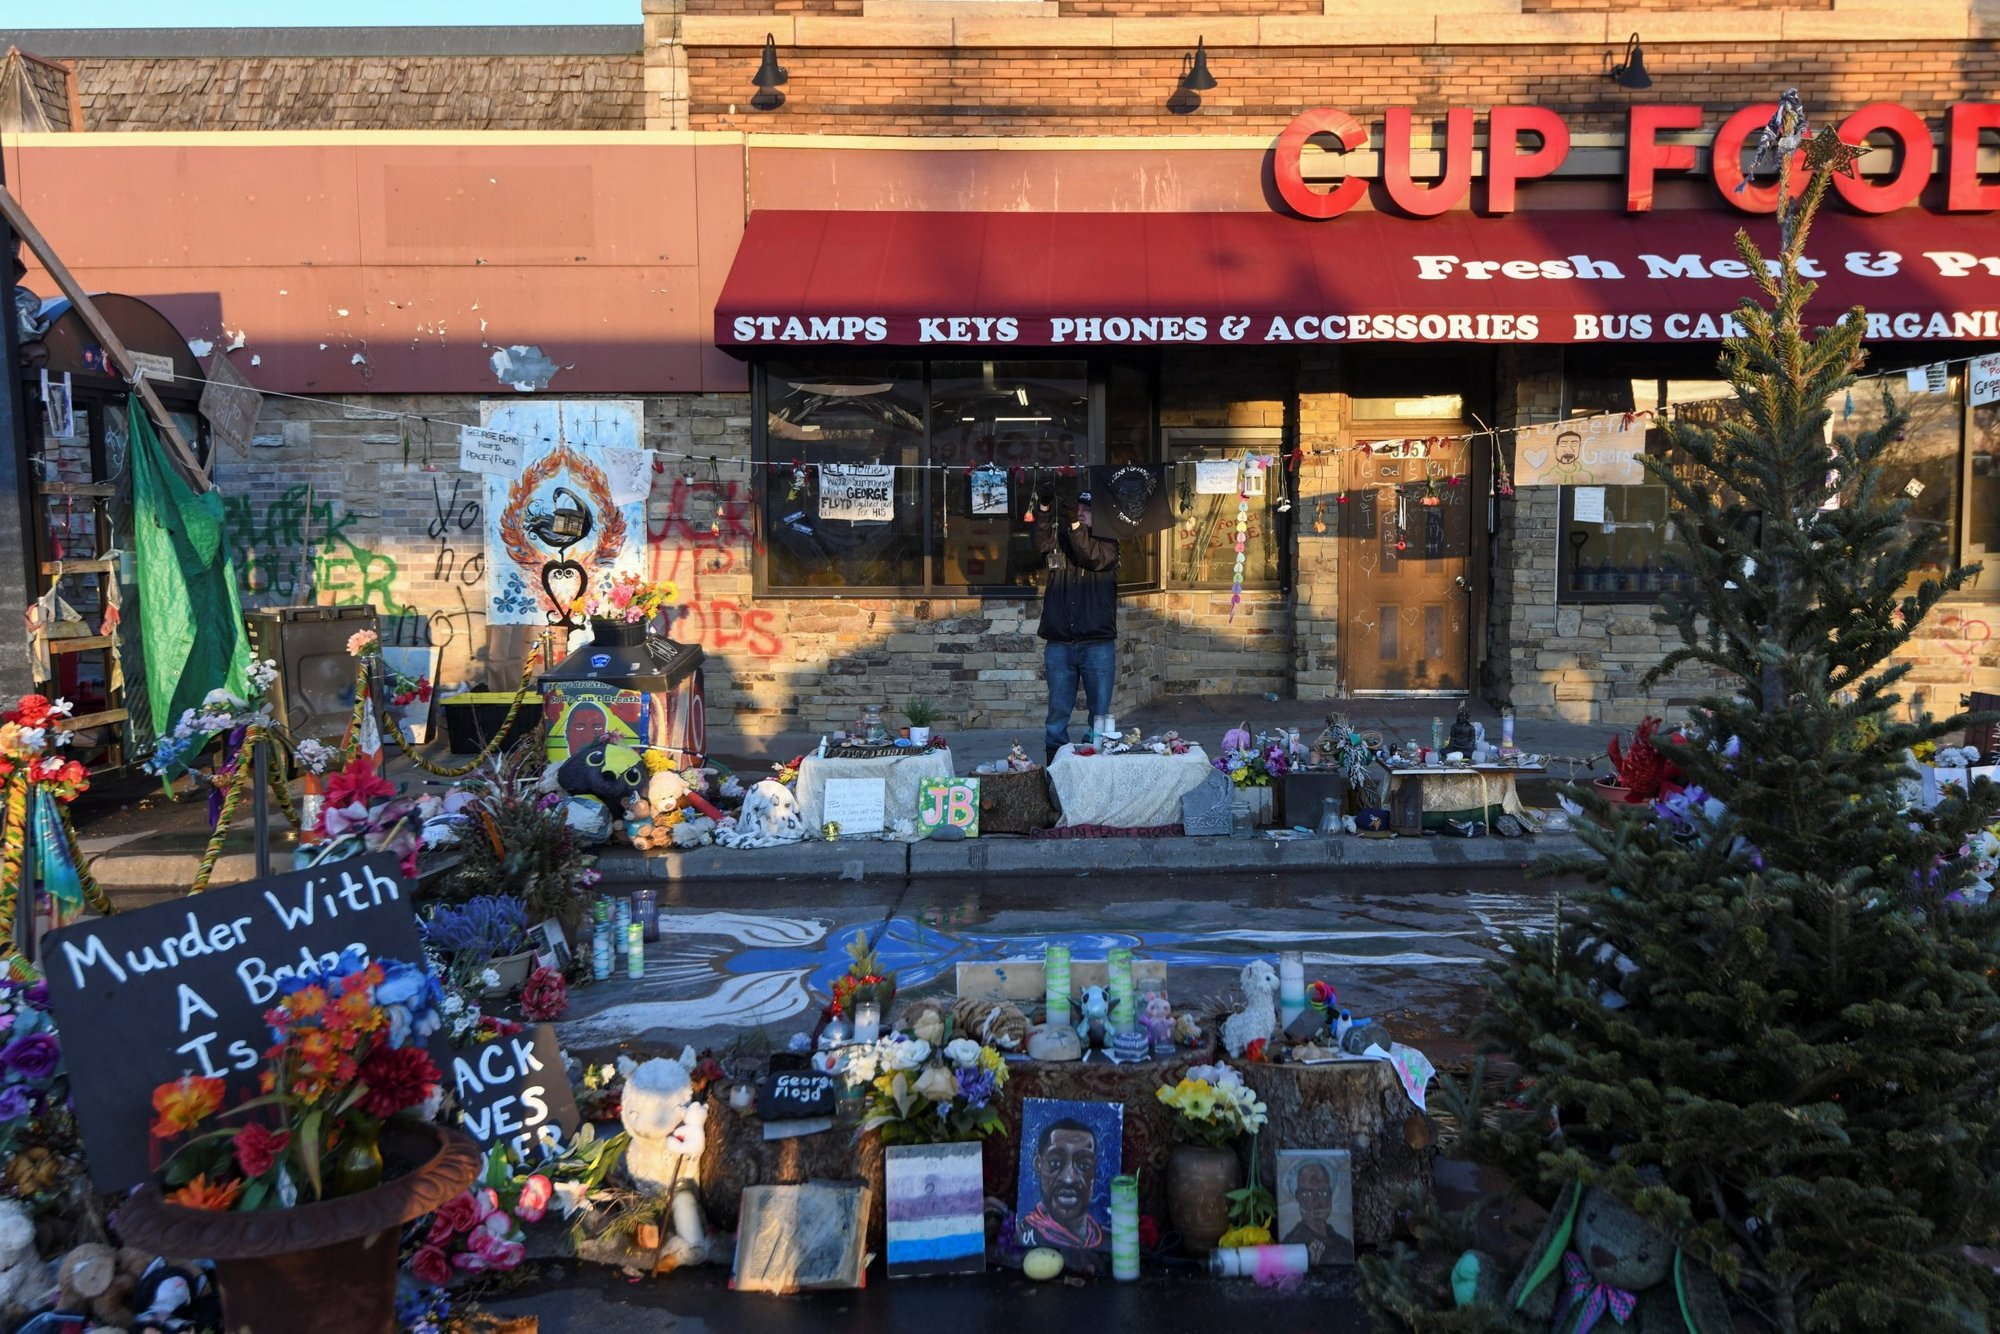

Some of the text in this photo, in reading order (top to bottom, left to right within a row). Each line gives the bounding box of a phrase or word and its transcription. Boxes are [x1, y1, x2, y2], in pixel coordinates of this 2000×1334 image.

[1274, 106, 1570, 218] CUP
[1412, 255, 1625, 280] Fresh
[1844, 251, 1902, 277] &
[733, 316, 887, 342] STAMPS
[918, 317, 1019, 343] KEYS
[1050, 317, 1207, 342] PHONES
[1219, 316, 1251, 341] &
[1263, 314, 1539, 341] ACCESSORIES
[1573, 314, 1652, 341] BUS
[466, 428, 498, 441] GEORGE
[821, 497, 852, 509] FLOYD
[846, 487, 889, 501] GEORGE
[922, 786, 976, 827] JB
[62, 864, 400, 989] Murder With
[177, 983, 218, 1034] A
[175, 1031, 259, 1079] Is
[453, 1038, 545, 1100] ACK
